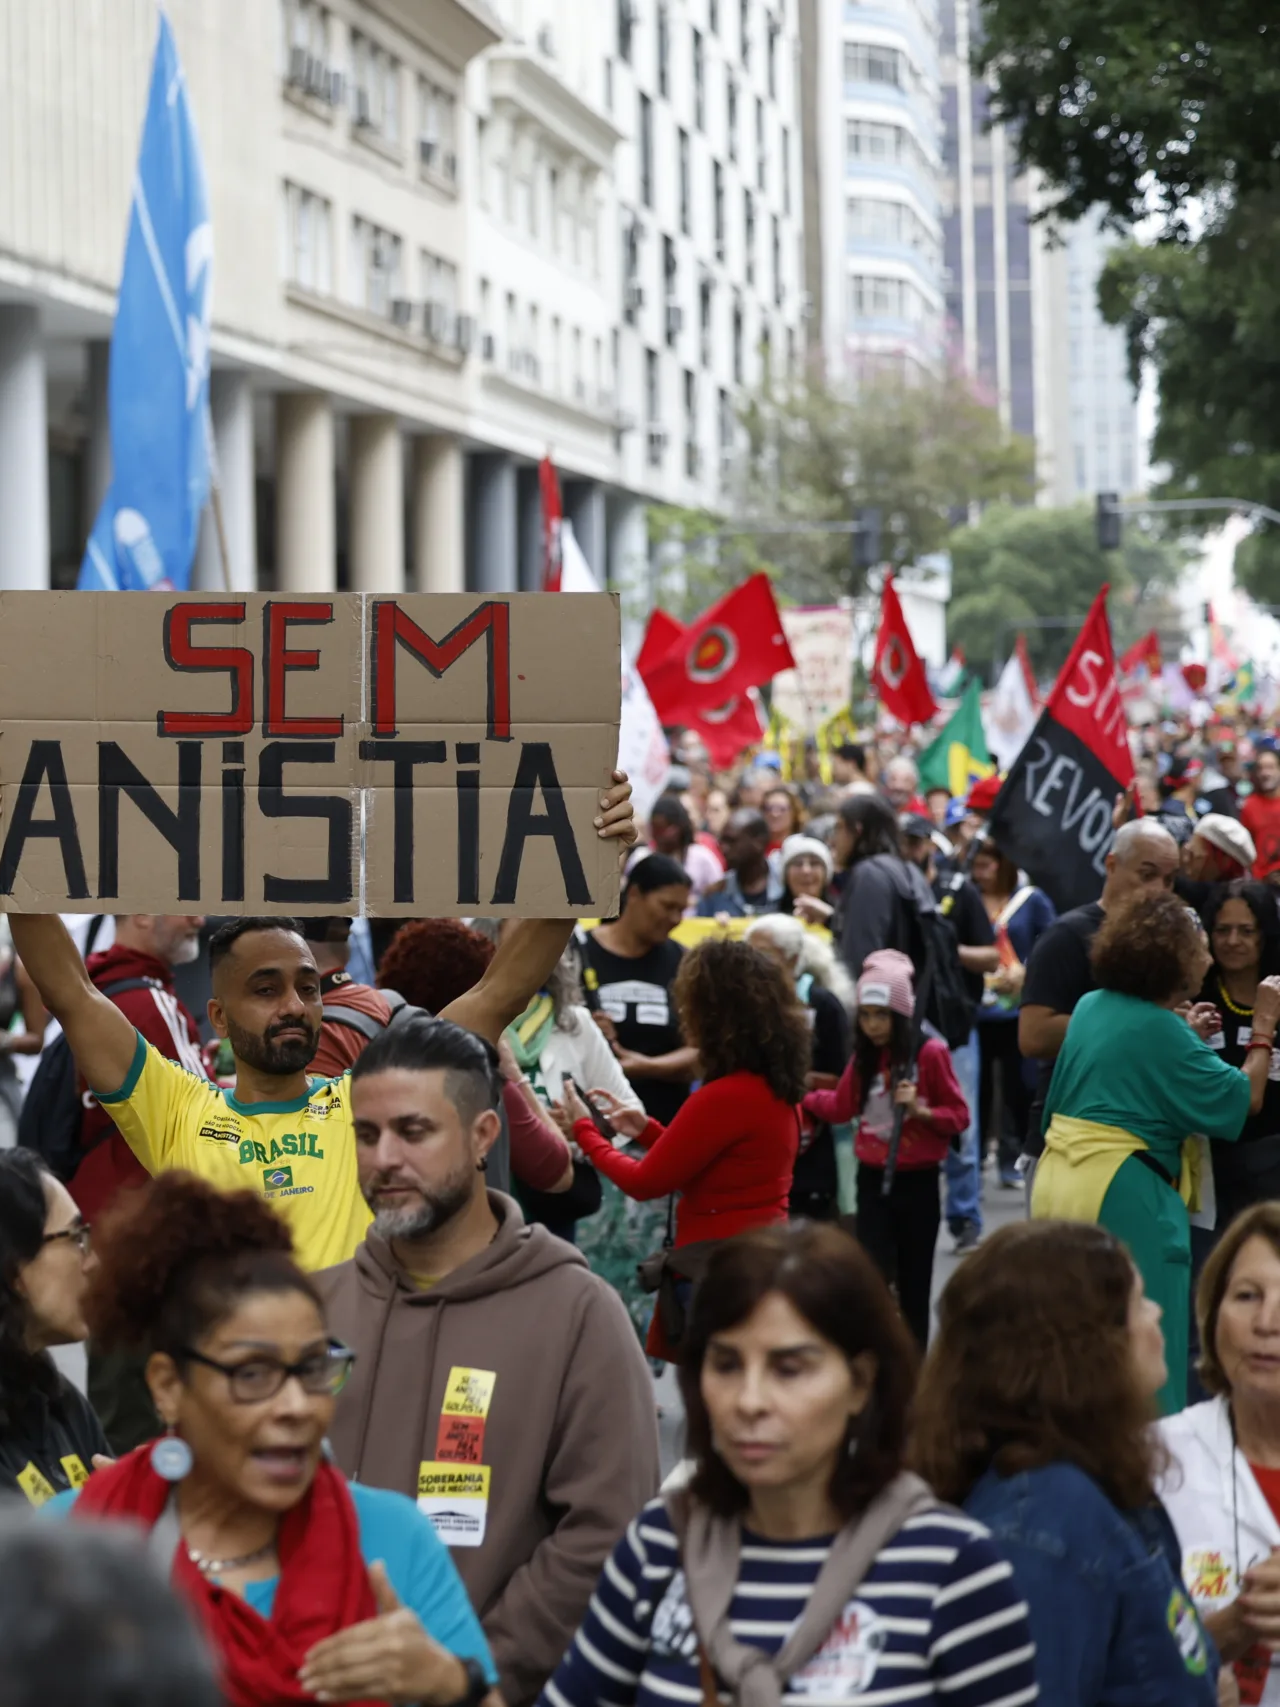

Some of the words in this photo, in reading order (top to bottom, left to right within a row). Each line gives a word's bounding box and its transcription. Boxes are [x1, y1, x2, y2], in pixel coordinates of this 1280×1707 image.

[157, 600, 513, 741] SEM
[239, 1132, 324, 1164] BRASIL
[280, 1186, 314, 1197] JANEIRO
[420, 1473, 484, 1485] SOBERANIA
